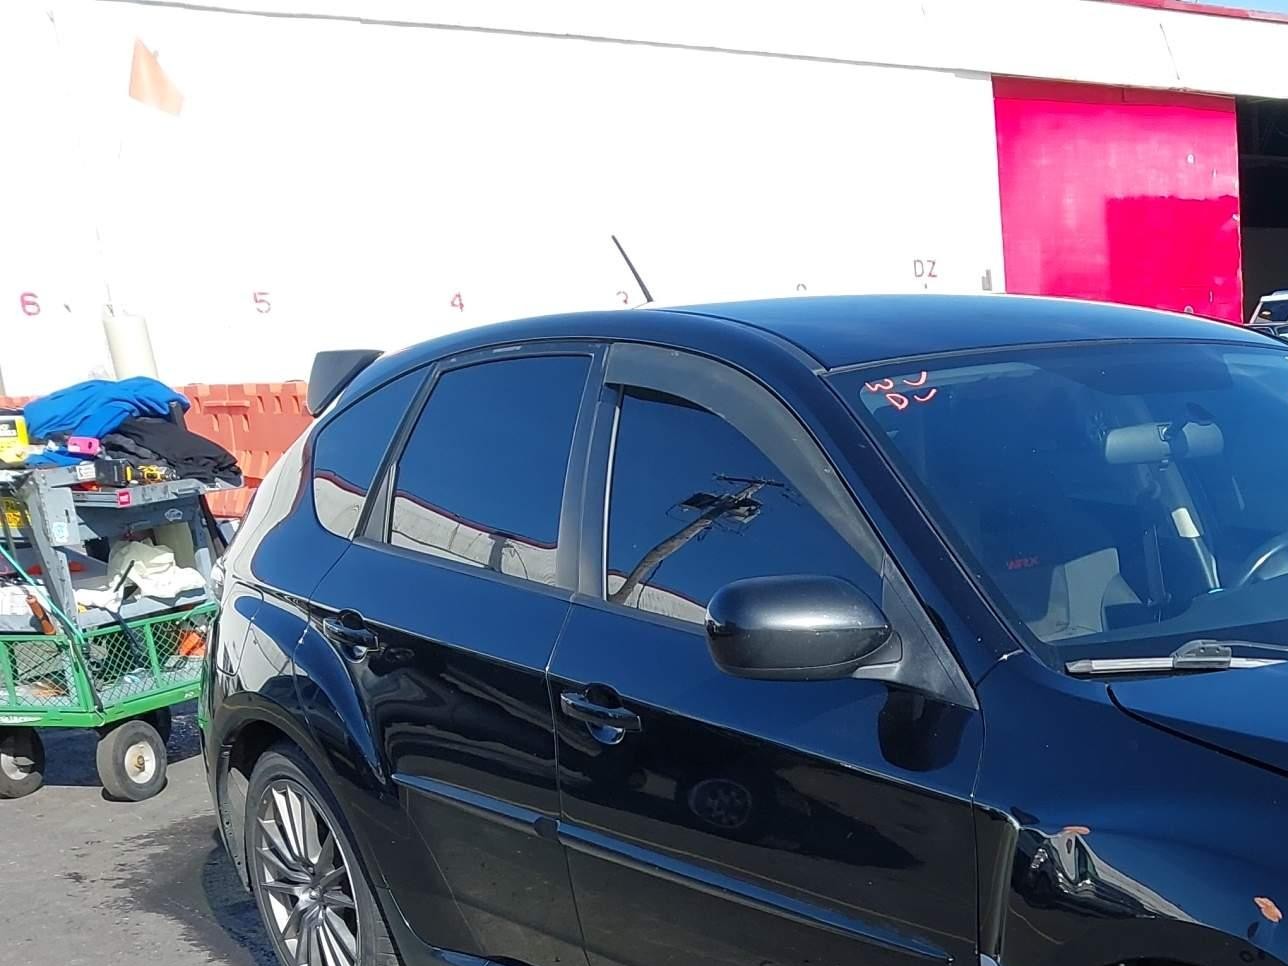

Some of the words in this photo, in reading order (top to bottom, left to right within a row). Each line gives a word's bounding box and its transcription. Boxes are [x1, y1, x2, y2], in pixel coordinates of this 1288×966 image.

[20, 292, 41, 316] 6
[253, 292, 272, 313] 5
[451, 291, 465, 312] 4
